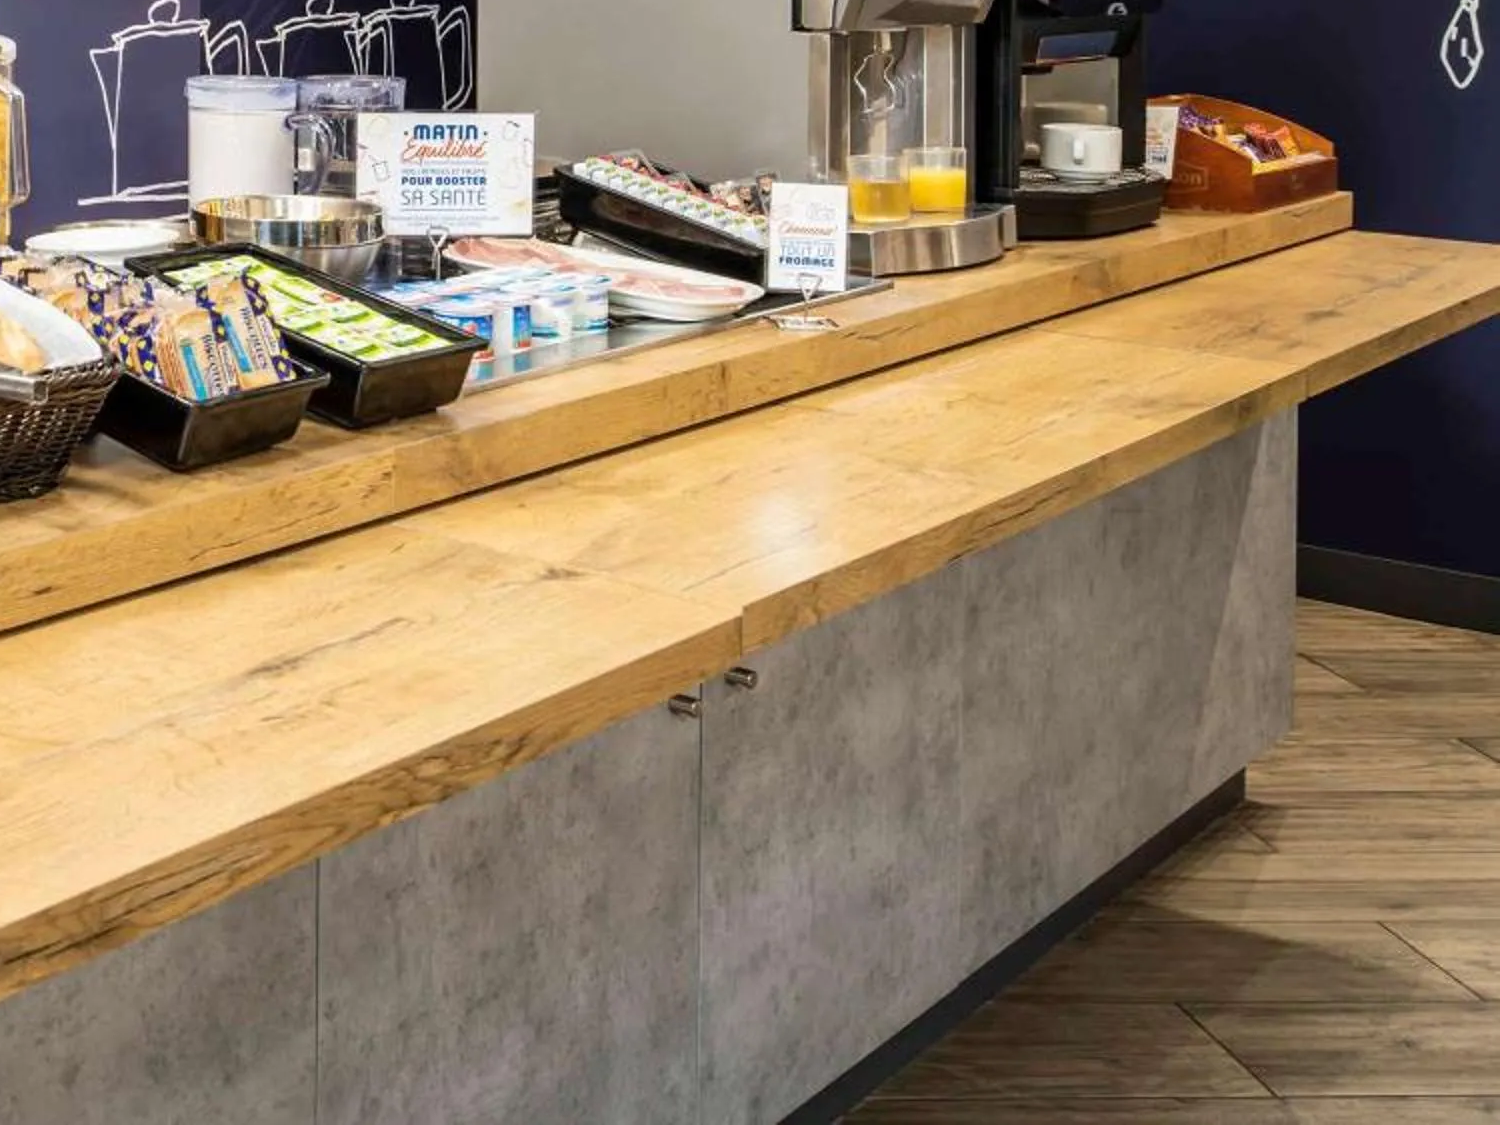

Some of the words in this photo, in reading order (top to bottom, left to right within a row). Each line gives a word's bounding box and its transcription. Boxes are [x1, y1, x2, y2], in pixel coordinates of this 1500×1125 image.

[413, 124, 479, 140] MATIN
[401, 176, 433, 185] POUR
[435, 176, 486, 185] BOOSTER
[401, 189, 423, 206] SA
[430, 186, 486, 206] SANTÉ
